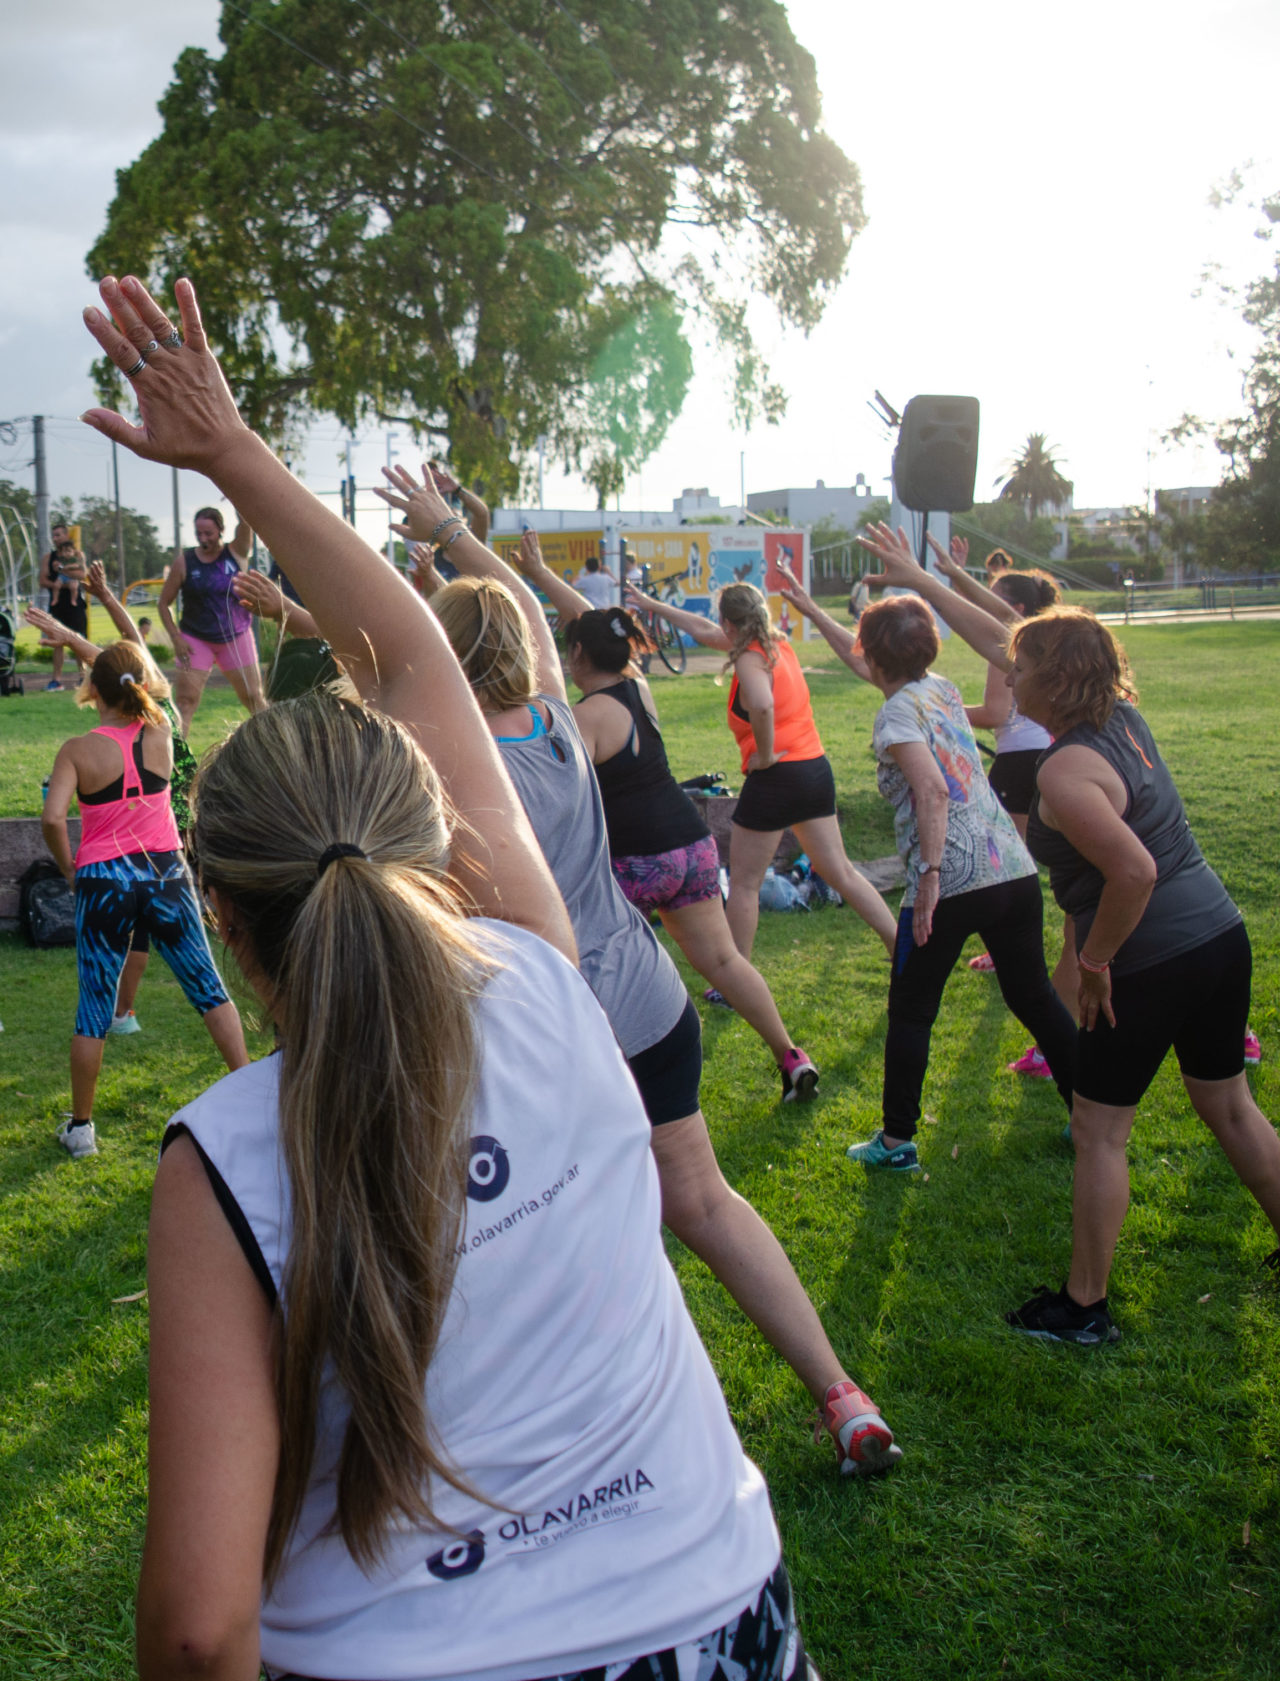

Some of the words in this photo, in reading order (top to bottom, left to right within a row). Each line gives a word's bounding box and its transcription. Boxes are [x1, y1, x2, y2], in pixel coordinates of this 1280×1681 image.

[568, 540, 595, 561] VIH
[451, 1164, 580, 1257] w.olavarria.gov.ar
[498, 1469, 657, 1541] OLAVARRIA
[534, 1534, 549, 1547] te
[591, 1513, 599, 1523] a
[602, 1500, 640, 1520] elegir
